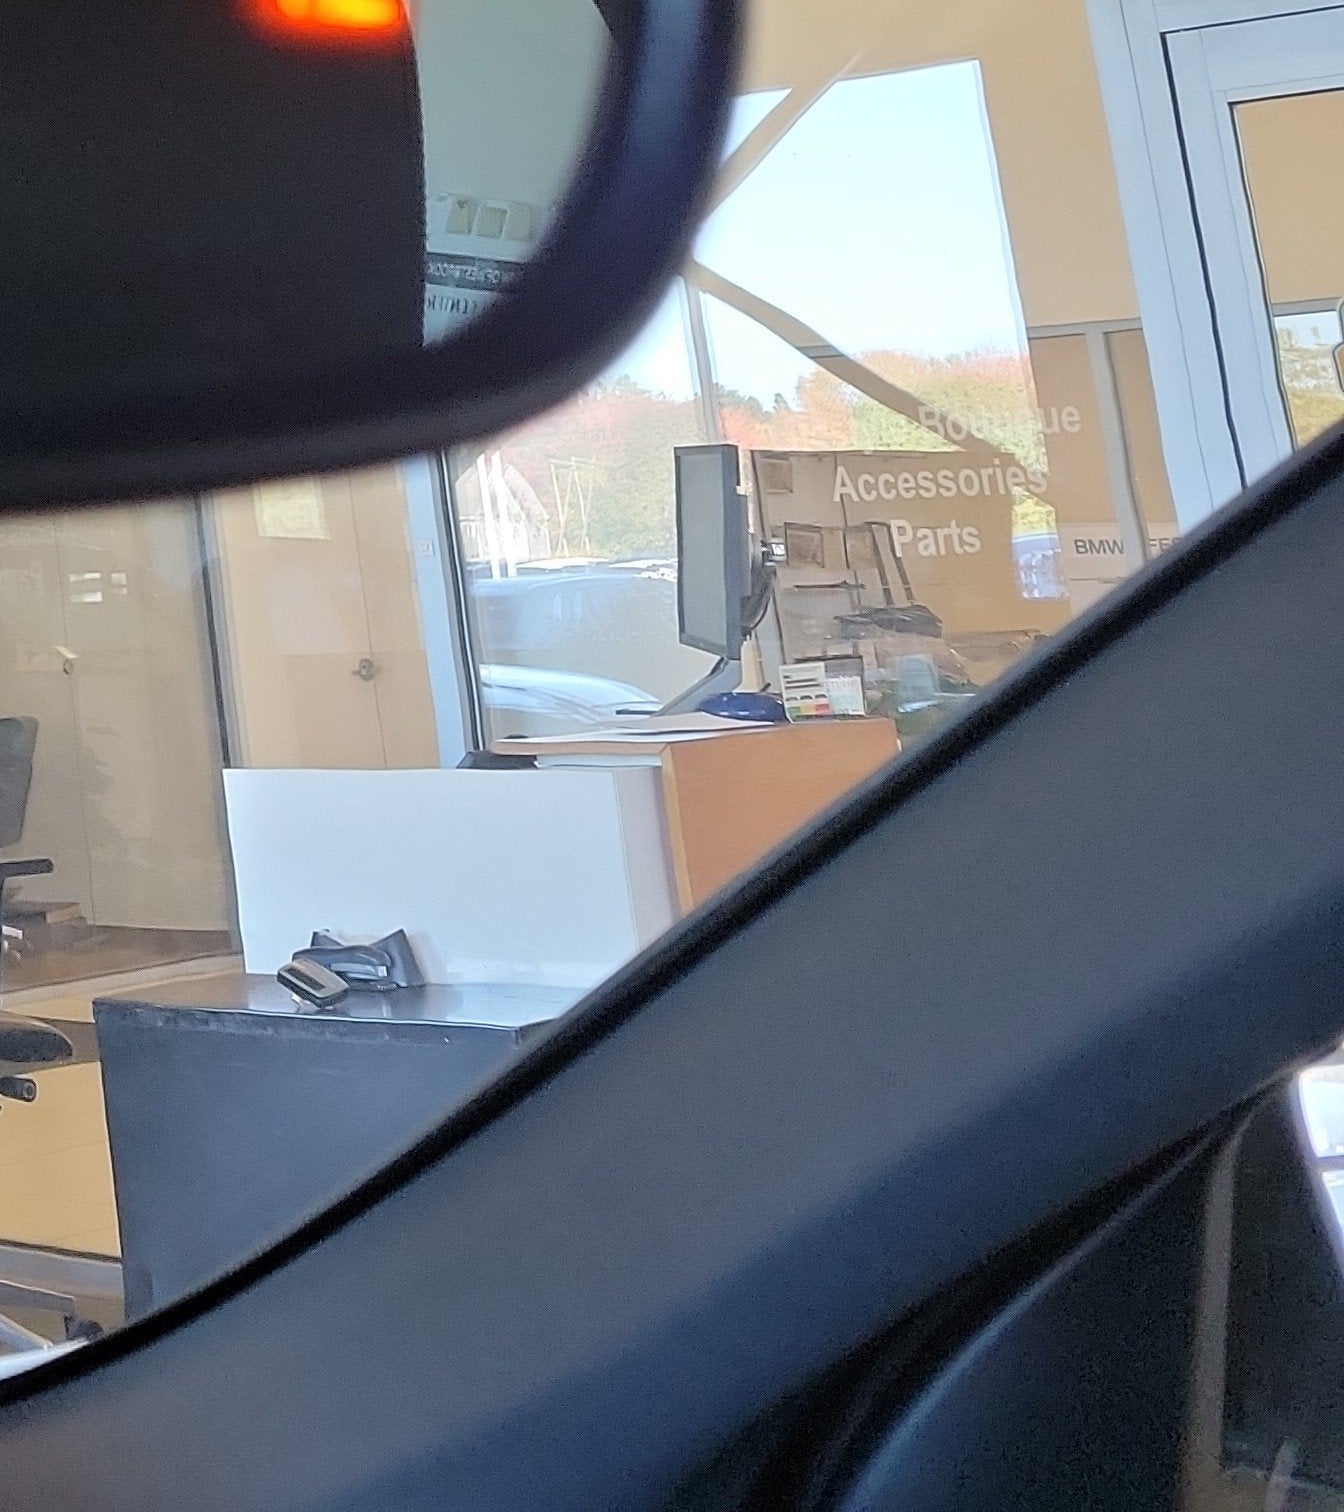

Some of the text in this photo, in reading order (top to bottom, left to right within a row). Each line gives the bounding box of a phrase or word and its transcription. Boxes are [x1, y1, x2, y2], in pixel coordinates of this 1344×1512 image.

[833, 458, 1048, 502] Accessories
[890, 519, 982, 557] Parts
[1074, 538, 1124, 555] BMW
